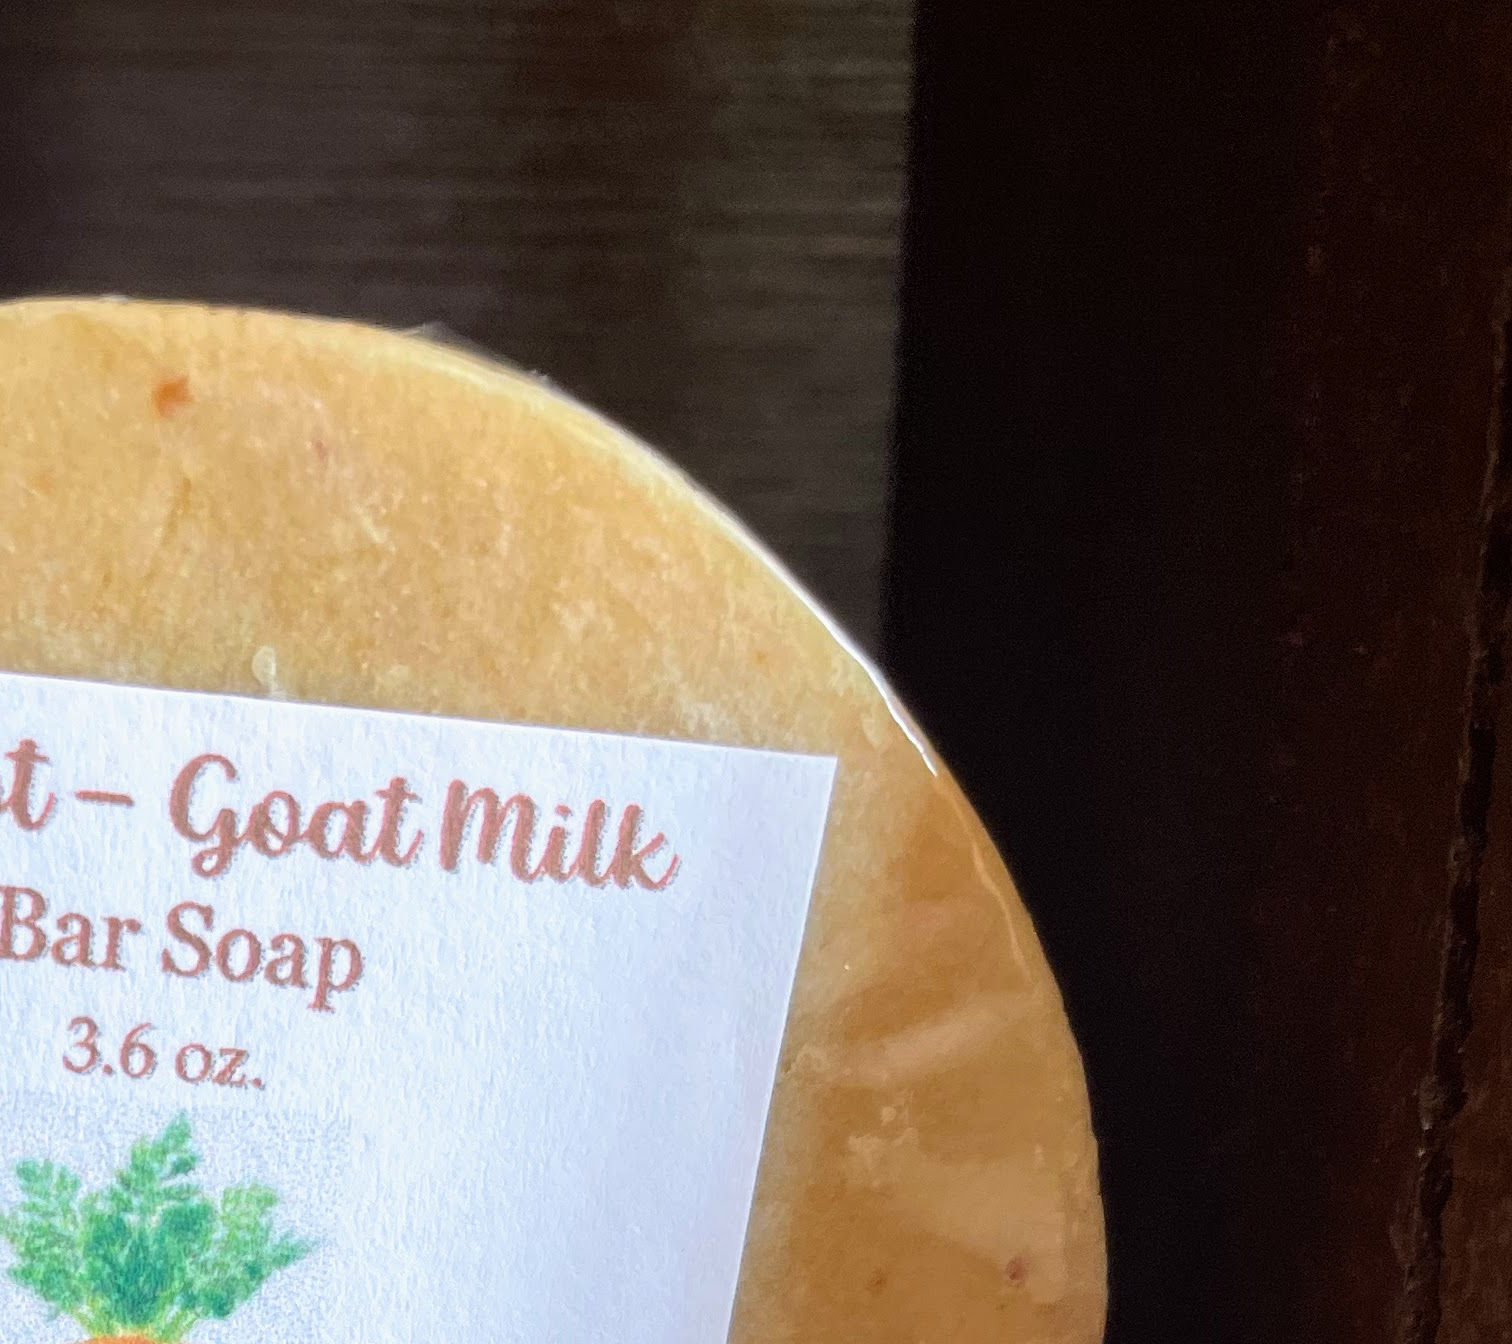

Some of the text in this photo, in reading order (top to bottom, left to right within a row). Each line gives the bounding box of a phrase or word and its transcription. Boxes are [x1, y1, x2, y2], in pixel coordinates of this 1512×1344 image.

[169, 753, 425, 876] Goat
[437, 779, 679, 890] Milk
[160, 902, 366, 1013] Soap
[62, 1017, 266, 1089] 3.6 oz.
